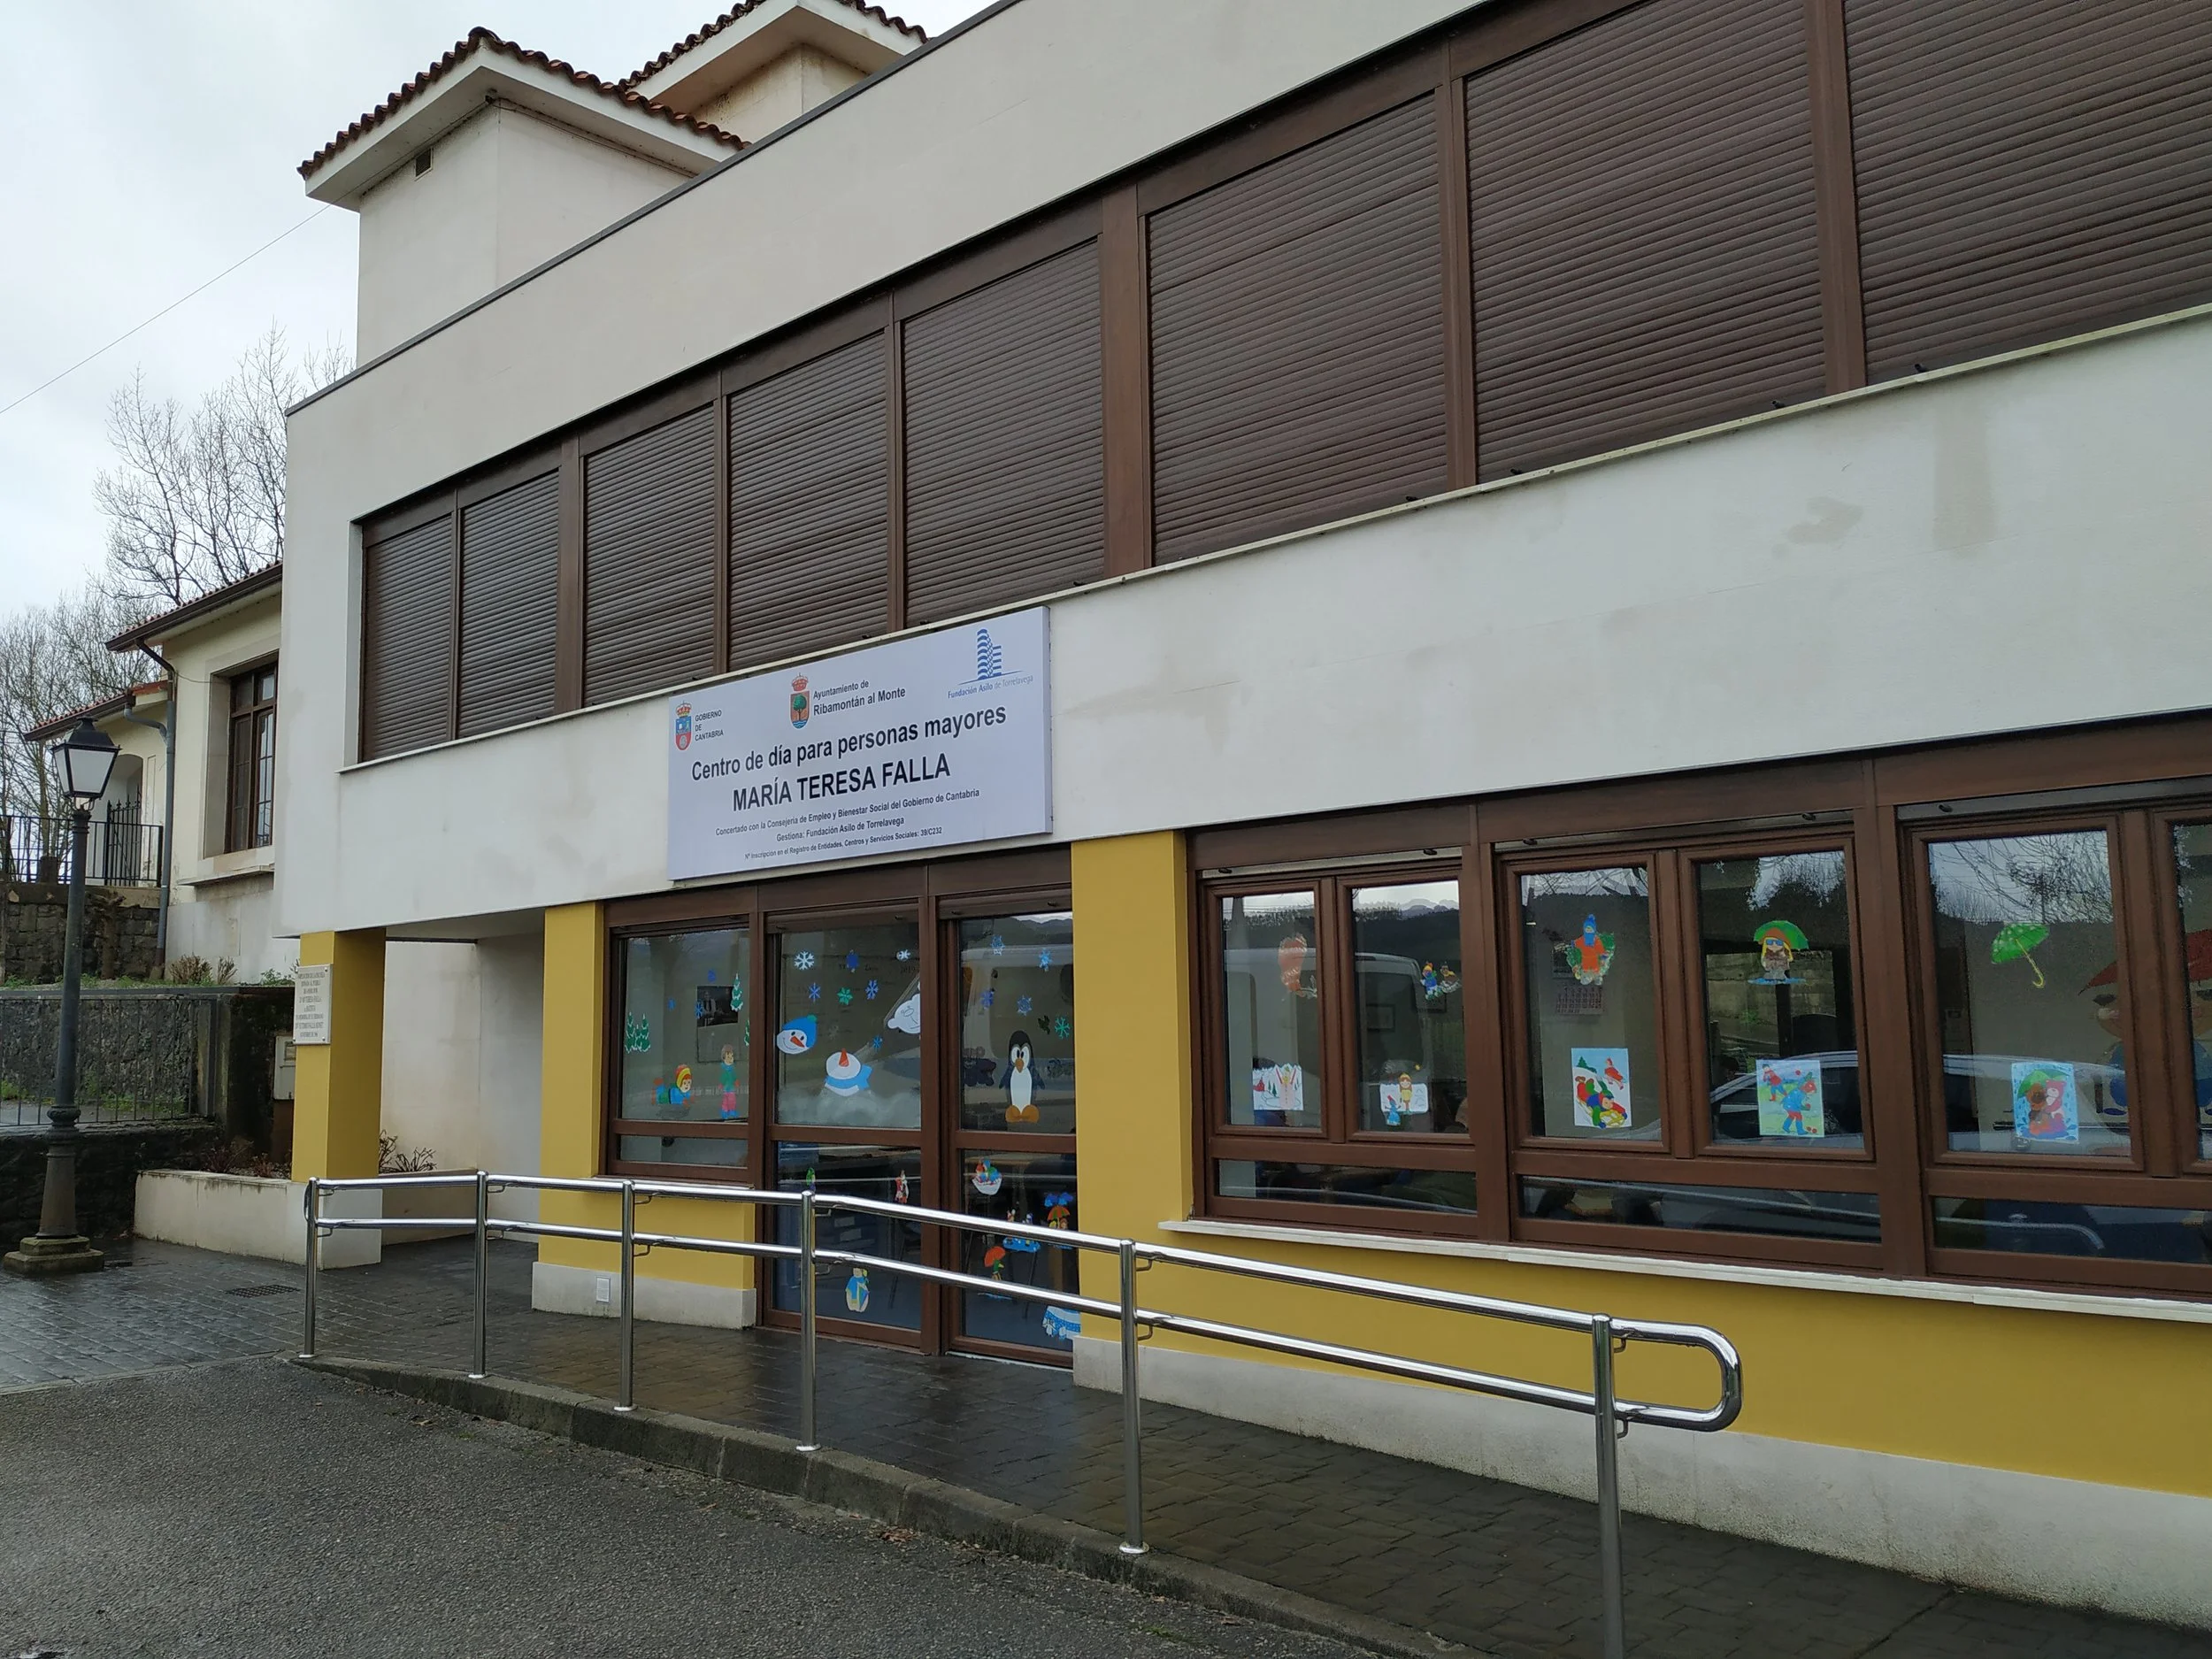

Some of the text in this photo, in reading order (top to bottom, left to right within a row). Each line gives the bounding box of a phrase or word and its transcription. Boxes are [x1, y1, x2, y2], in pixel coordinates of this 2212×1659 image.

[813, 680, 869, 701] Ayuntamiento de
[947, 686, 977, 699] Fundación
[979, 683, 993, 692] Asilo
[1002, 675, 1033, 688] Torrelavega
[814, 687, 906, 716] Ribamontán al Monte
[695, 710, 722, 722] GOBIERNO
[692, 706, 1007, 781] Centro de día para personas mayores
[695, 729, 724, 741] CANTABRIA
[733, 752, 950, 812] MARÍA TERESA FALLA
[715, 825, 749, 835] Concertado
[749, 823, 760, 832] con
[808, 812, 832, 823] Empleo
[832, 811, 837, 820] y
[838, 806, 868, 818] Bienestar
[869, 802, 890, 812] Social
[890, 799, 901, 810] del
[902, 795, 934, 808] Gobierno
[935, 794, 944, 803] de
[945, 789, 980, 802] Cantabria
[777, 817, 904, 842] Gestiona: Fundación Asilo de Torrelavega
[789, 846, 810, 855] Registro
[869, 834, 894, 843] Servicios
[895, 831, 920, 841] Sociales:
